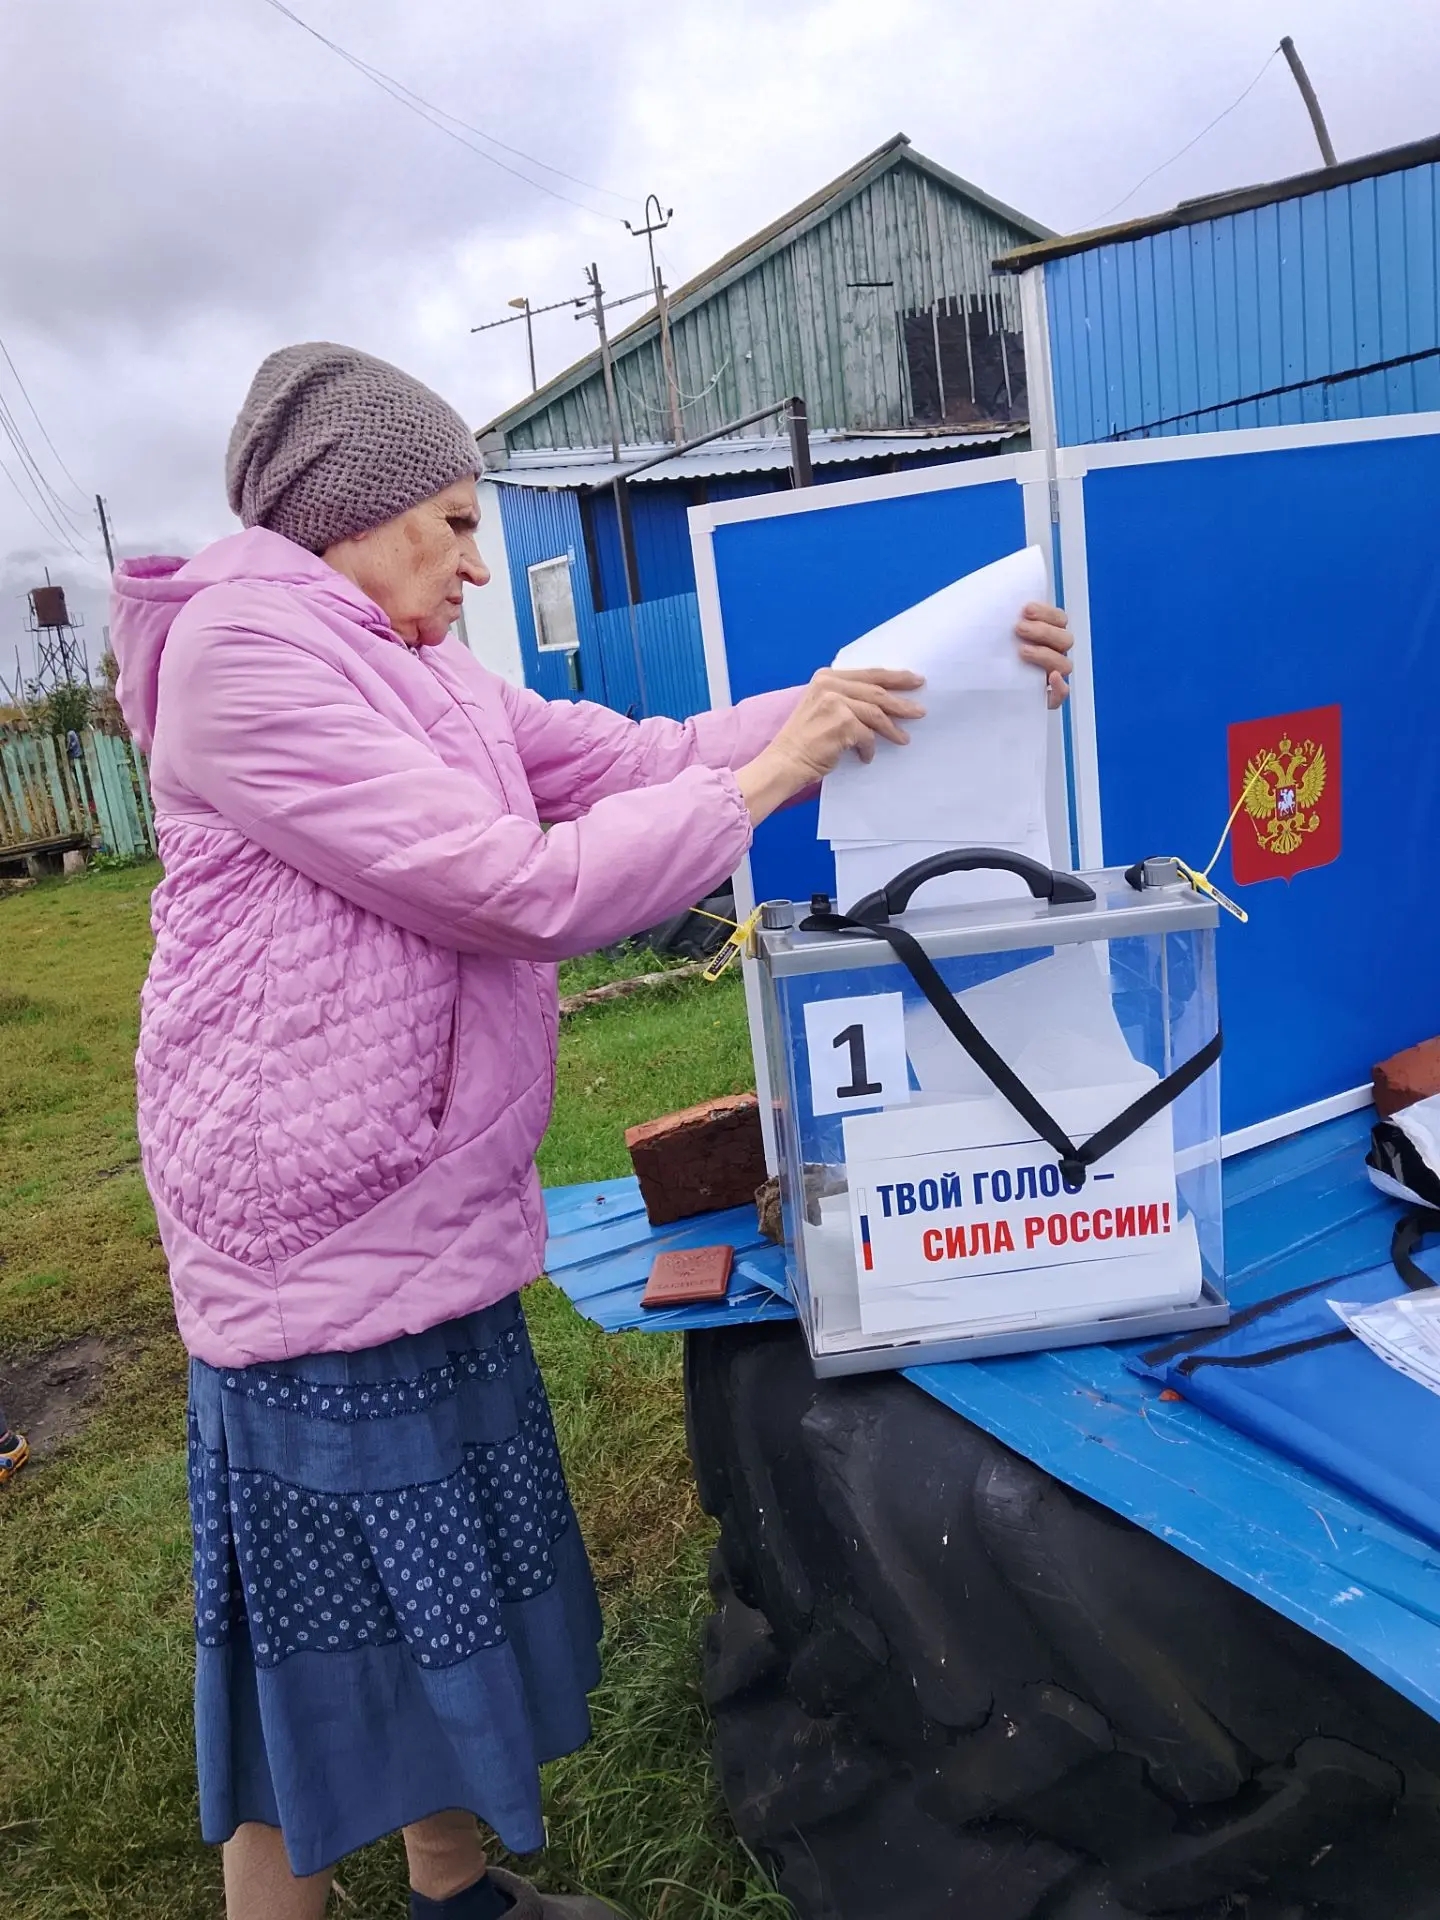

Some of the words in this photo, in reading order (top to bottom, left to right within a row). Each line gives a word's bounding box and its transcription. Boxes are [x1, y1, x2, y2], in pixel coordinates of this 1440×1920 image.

[832, 1023, 883, 1099] 1
[876, 1171, 963, 1218] ТВОЙ
[922, 1220, 1015, 1262] СИЛА
[1024, 1202, 1171, 1249] РОССИИ!
